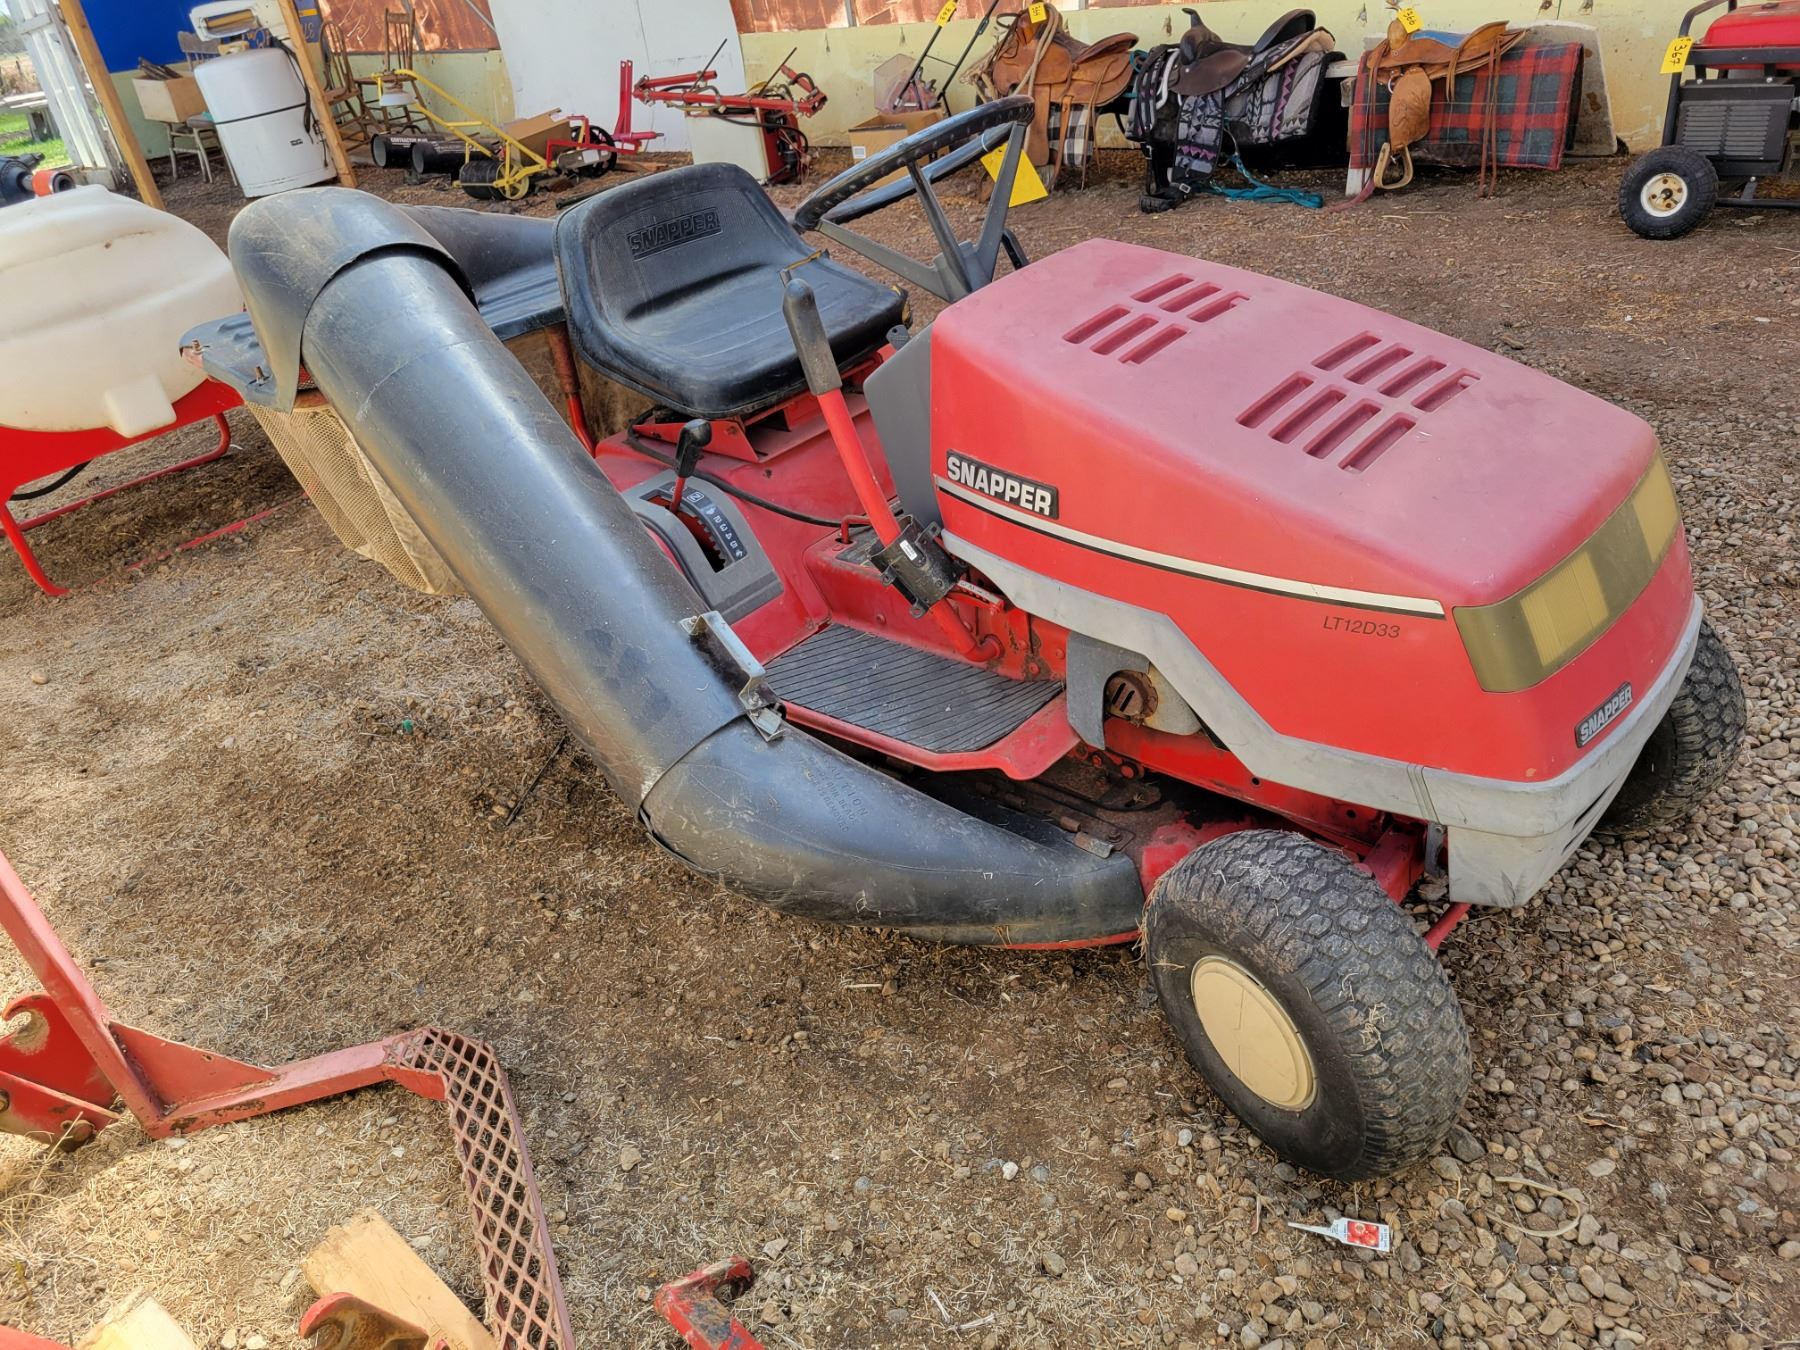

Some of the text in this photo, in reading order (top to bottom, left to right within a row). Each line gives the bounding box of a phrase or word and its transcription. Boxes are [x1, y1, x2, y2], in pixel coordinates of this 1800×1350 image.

[1670, 44, 1687, 65] 367
[629, 210, 721, 252] SNAPPER
[947, 456, 1052, 516] SNAPPER
[1323, 615, 1400, 638] LT12D33
[1580, 686, 1632, 740] SNAPPER
